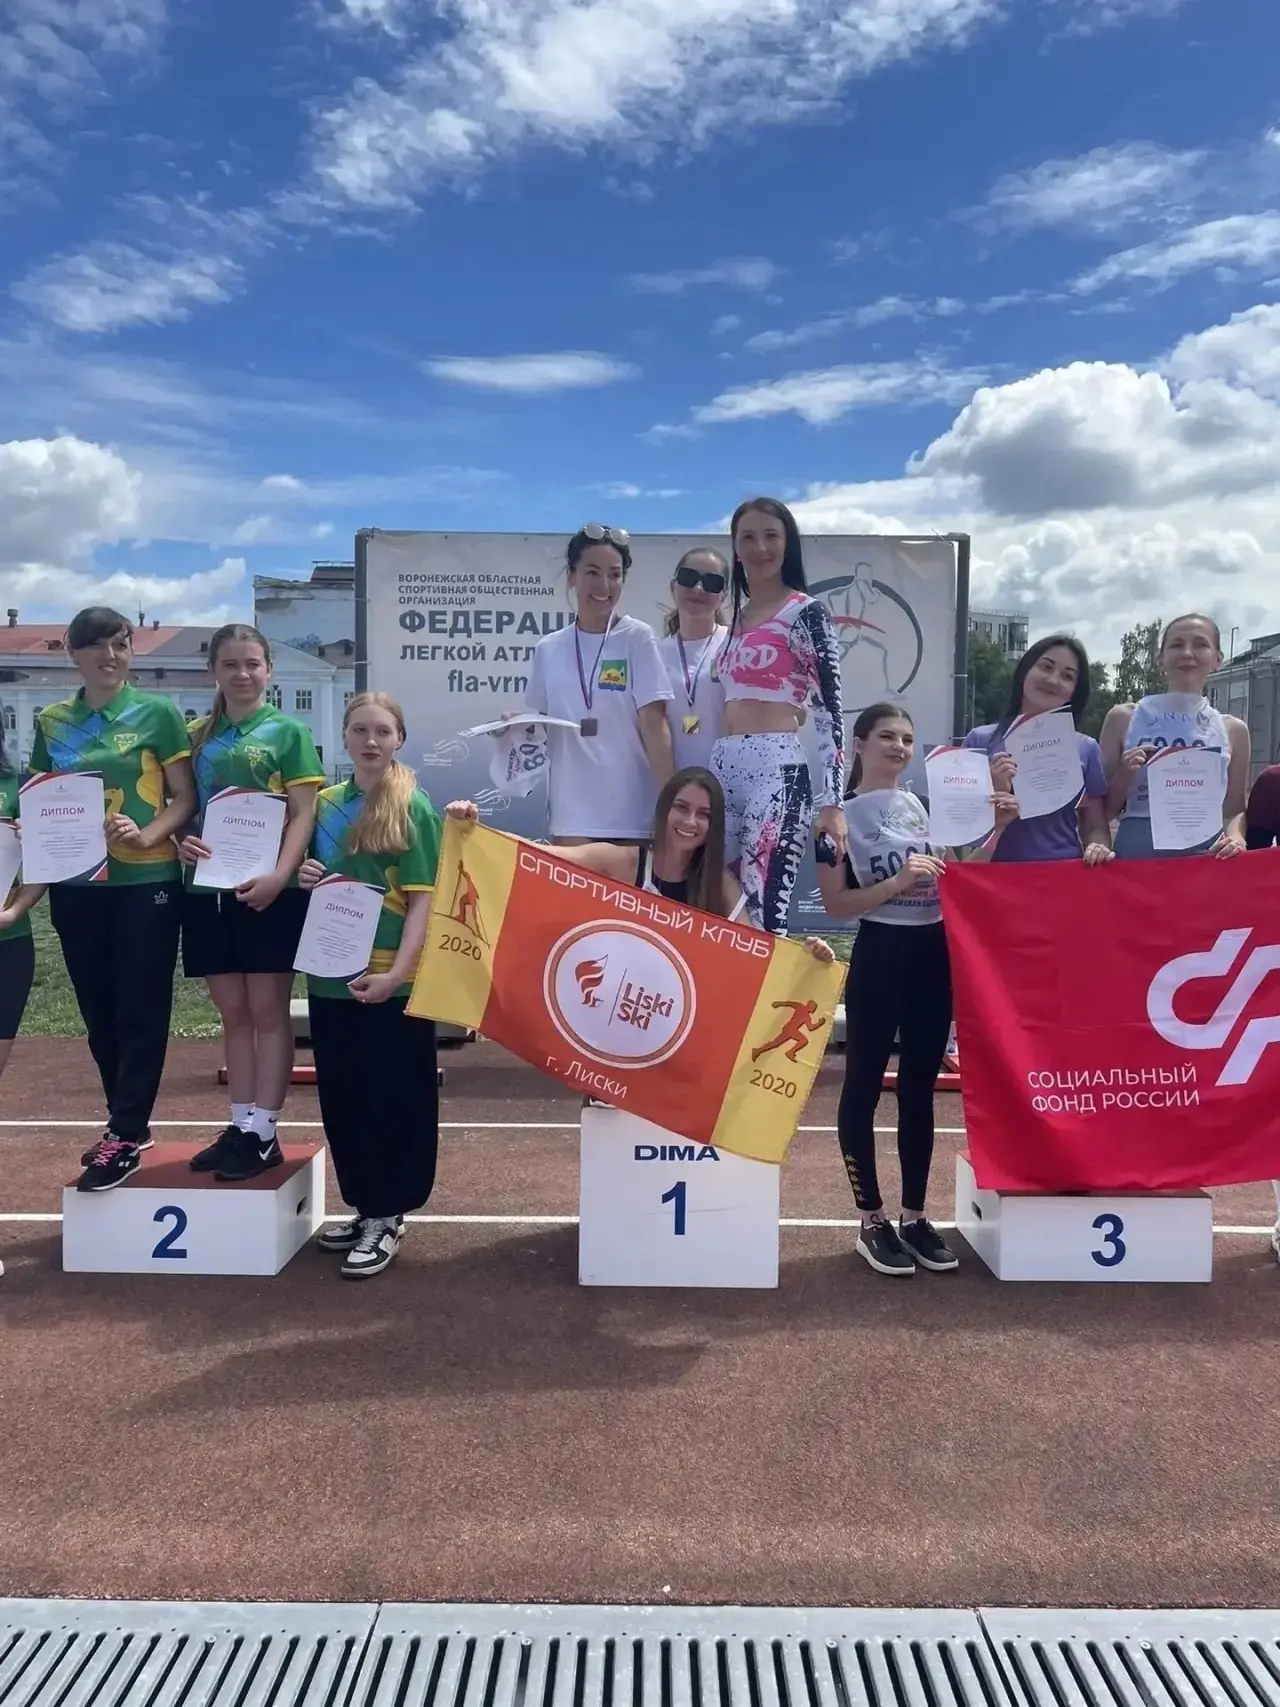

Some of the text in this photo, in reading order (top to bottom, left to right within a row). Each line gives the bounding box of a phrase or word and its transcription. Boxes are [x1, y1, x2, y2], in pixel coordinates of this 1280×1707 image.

[398, 574, 541, 585] ВОРОНЕЖСКАЯ ОБЛАСТНАЯ
[398, 585, 554, 596] СПОРТИВНАЯ ОБЩЕСТВЕННАЯ
[398, 596, 476, 607] ОРГАНИЗАЦИЯ
[400, 641, 536, 662] ЛЕГКОЙ АТЛ
[1023, 738, 1061, 752] ДИПЛОМ
[943, 776, 978, 785] ДИПЛОМ
[1165, 779, 1204, 787] ДИПЛОМ
[40, 807, 85, 817] ДИПЛОМ
[222, 816, 266, 829] ДИПЛОМ
[325, 903, 364, 920] ДИПЛОМ
[520, 852, 770, 958] СПОРТИВНЫЙ КЛУБ
[438, 934, 482, 961] 2020
[623, 982, 675, 1017] Liski
[617, 1002, 652, 1031] Ski
[546, 1056, 628, 1098] г. Лиски
[749, 1069, 797, 1099] 2020
[1027, 1062, 1197, 1091] СОЦИАЛЬНЫЙ
[1031, 1090, 1200, 1114] ФОНД РОССИИ
[634, 1145, 720, 1161] DIMA
[661, 1181, 686, 1235] 1
[151, 1205, 188, 1259] 2
[1090, 1213, 1127, 1267] 3
